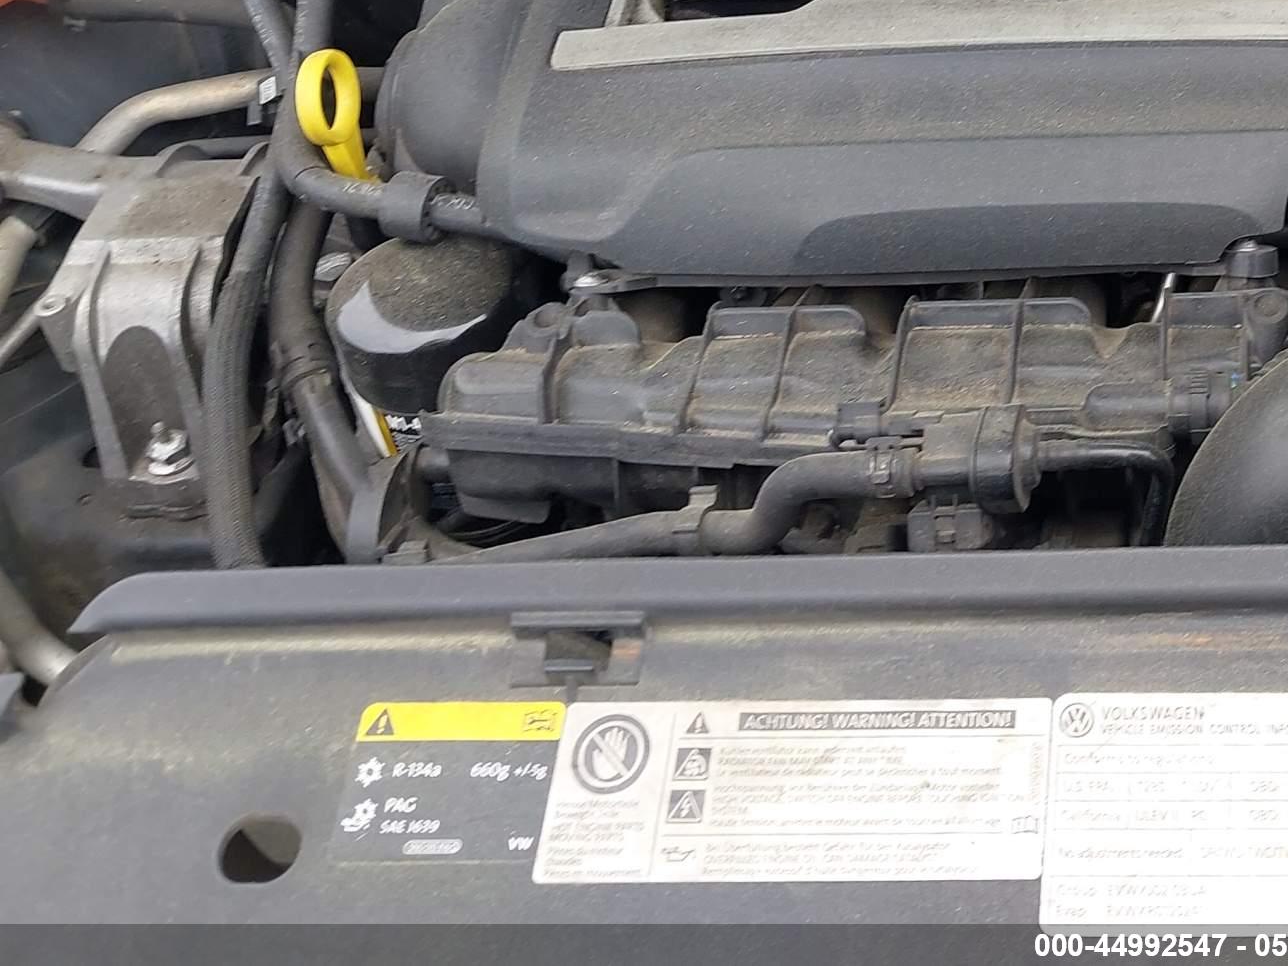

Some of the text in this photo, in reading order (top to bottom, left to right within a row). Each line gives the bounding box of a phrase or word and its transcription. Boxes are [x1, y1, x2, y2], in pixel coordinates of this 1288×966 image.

[743, 710, 1012, 730] ACHTUNG! WARNING! ATTENTION!
[1102, 706, 1205, 720] VOLKSWAGEN
